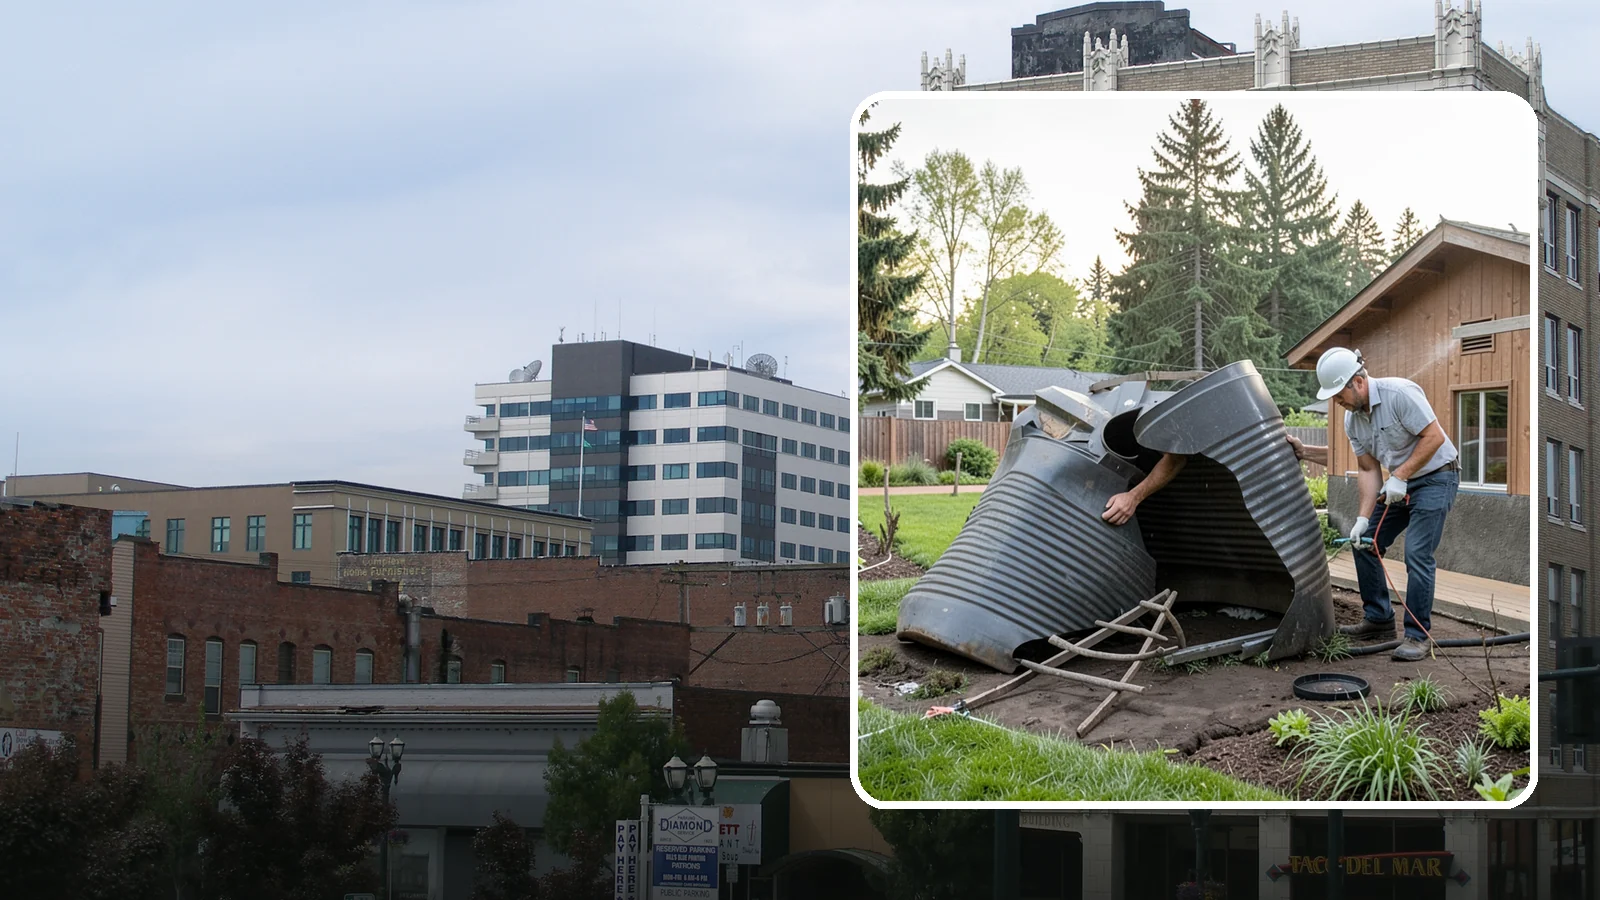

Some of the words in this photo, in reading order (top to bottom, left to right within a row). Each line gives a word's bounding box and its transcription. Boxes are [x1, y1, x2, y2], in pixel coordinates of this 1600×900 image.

[343, 568, 368, 577] Home
[370, 566, 427, 576] Furnishers
[660, 818, 713, 833] DIAMOND
[1022, 815, 1069, 828] BUILDING
[617, 825, 625, 852] PAY
[628, 824, 636, 852] PAY
[655, 845, 688, 853] RESERVED
[689, 846, 716, 854] PARKING
[721, 851, 739, 862] Soup
[671, 862, 701, 870] PATRONS
[1289, 855, 1329, 875] TAC
[1346, 856, 1384, 876] DEL
[1392, 857, 1442, 877] MAR
[616, 856, 624, 893] HERE
[627, 856, 636, 893] HERE
[660, 889, 682, 897] PUBLIC
[683, 889, 710, 898] PARKING
